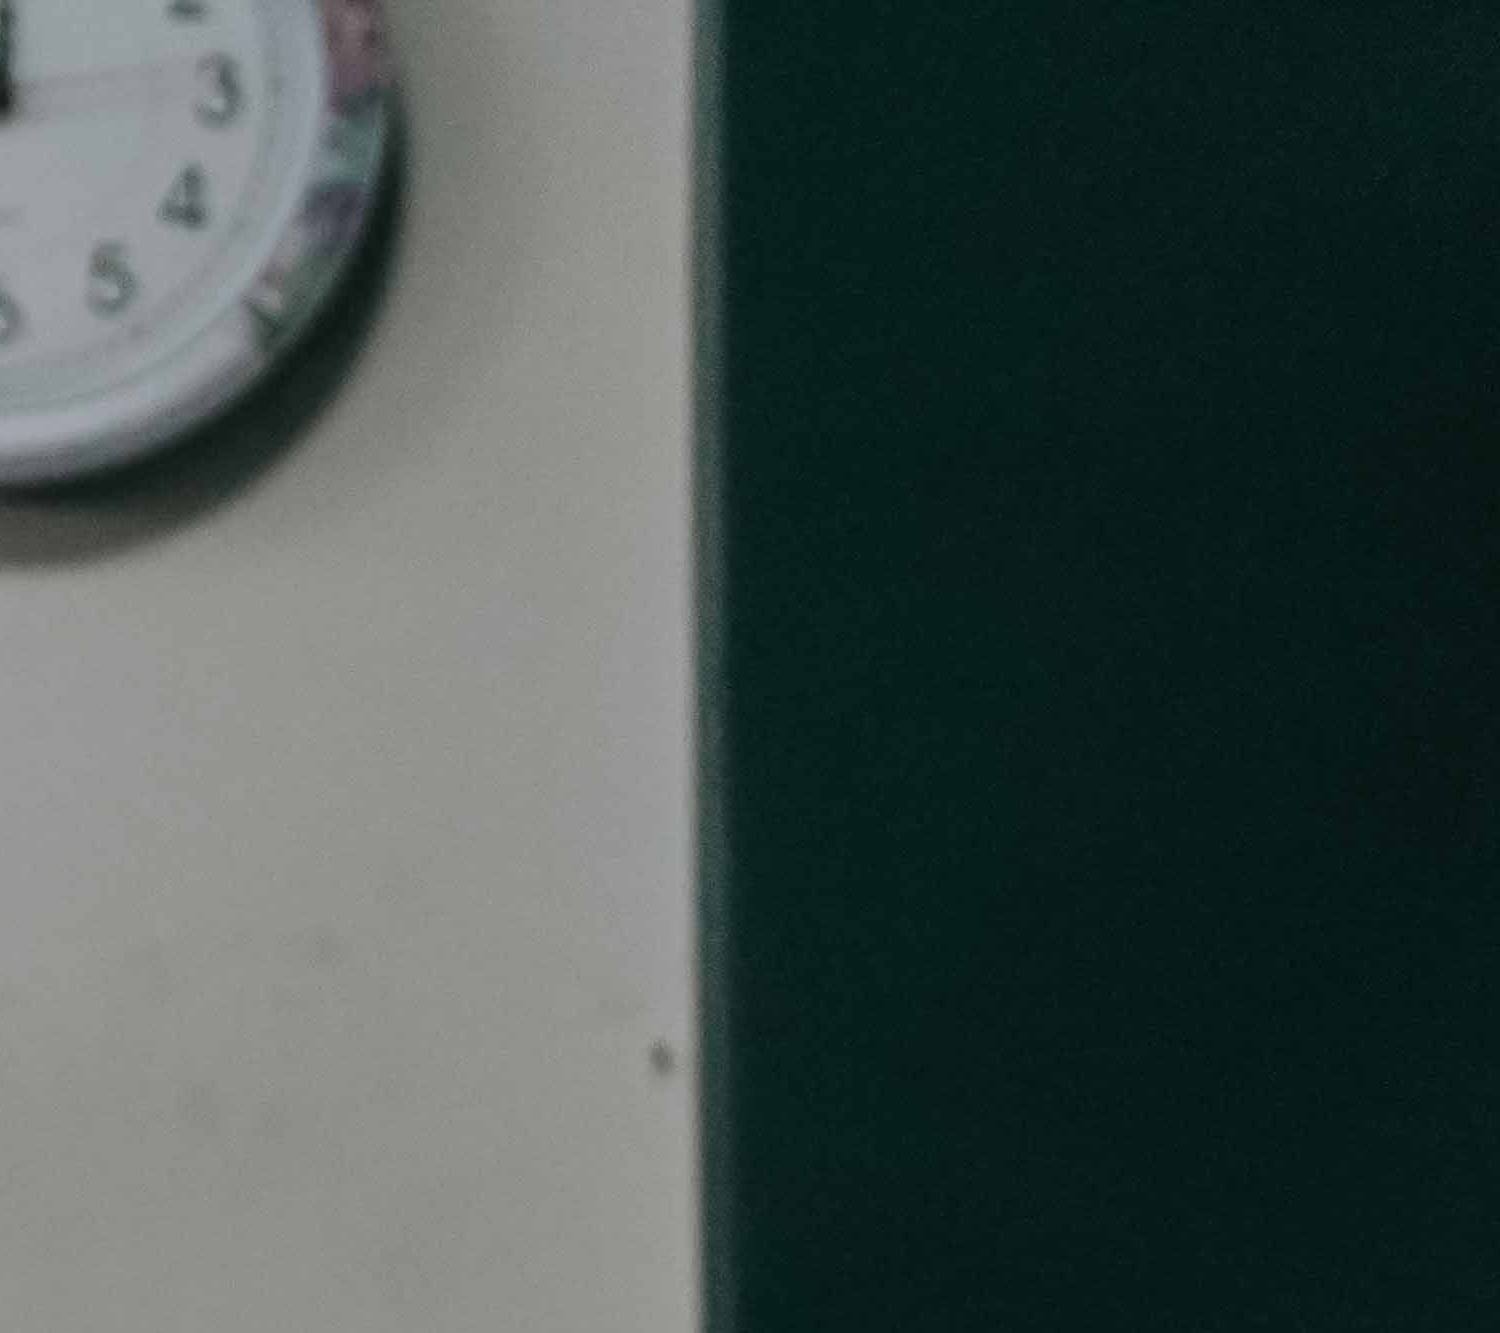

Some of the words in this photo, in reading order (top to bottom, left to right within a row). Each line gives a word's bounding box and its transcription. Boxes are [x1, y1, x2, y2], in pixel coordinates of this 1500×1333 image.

[196, 50, 242, 127] 3
[160, 163, 208, 229] 4
[90, 242, 138, 318] 5
